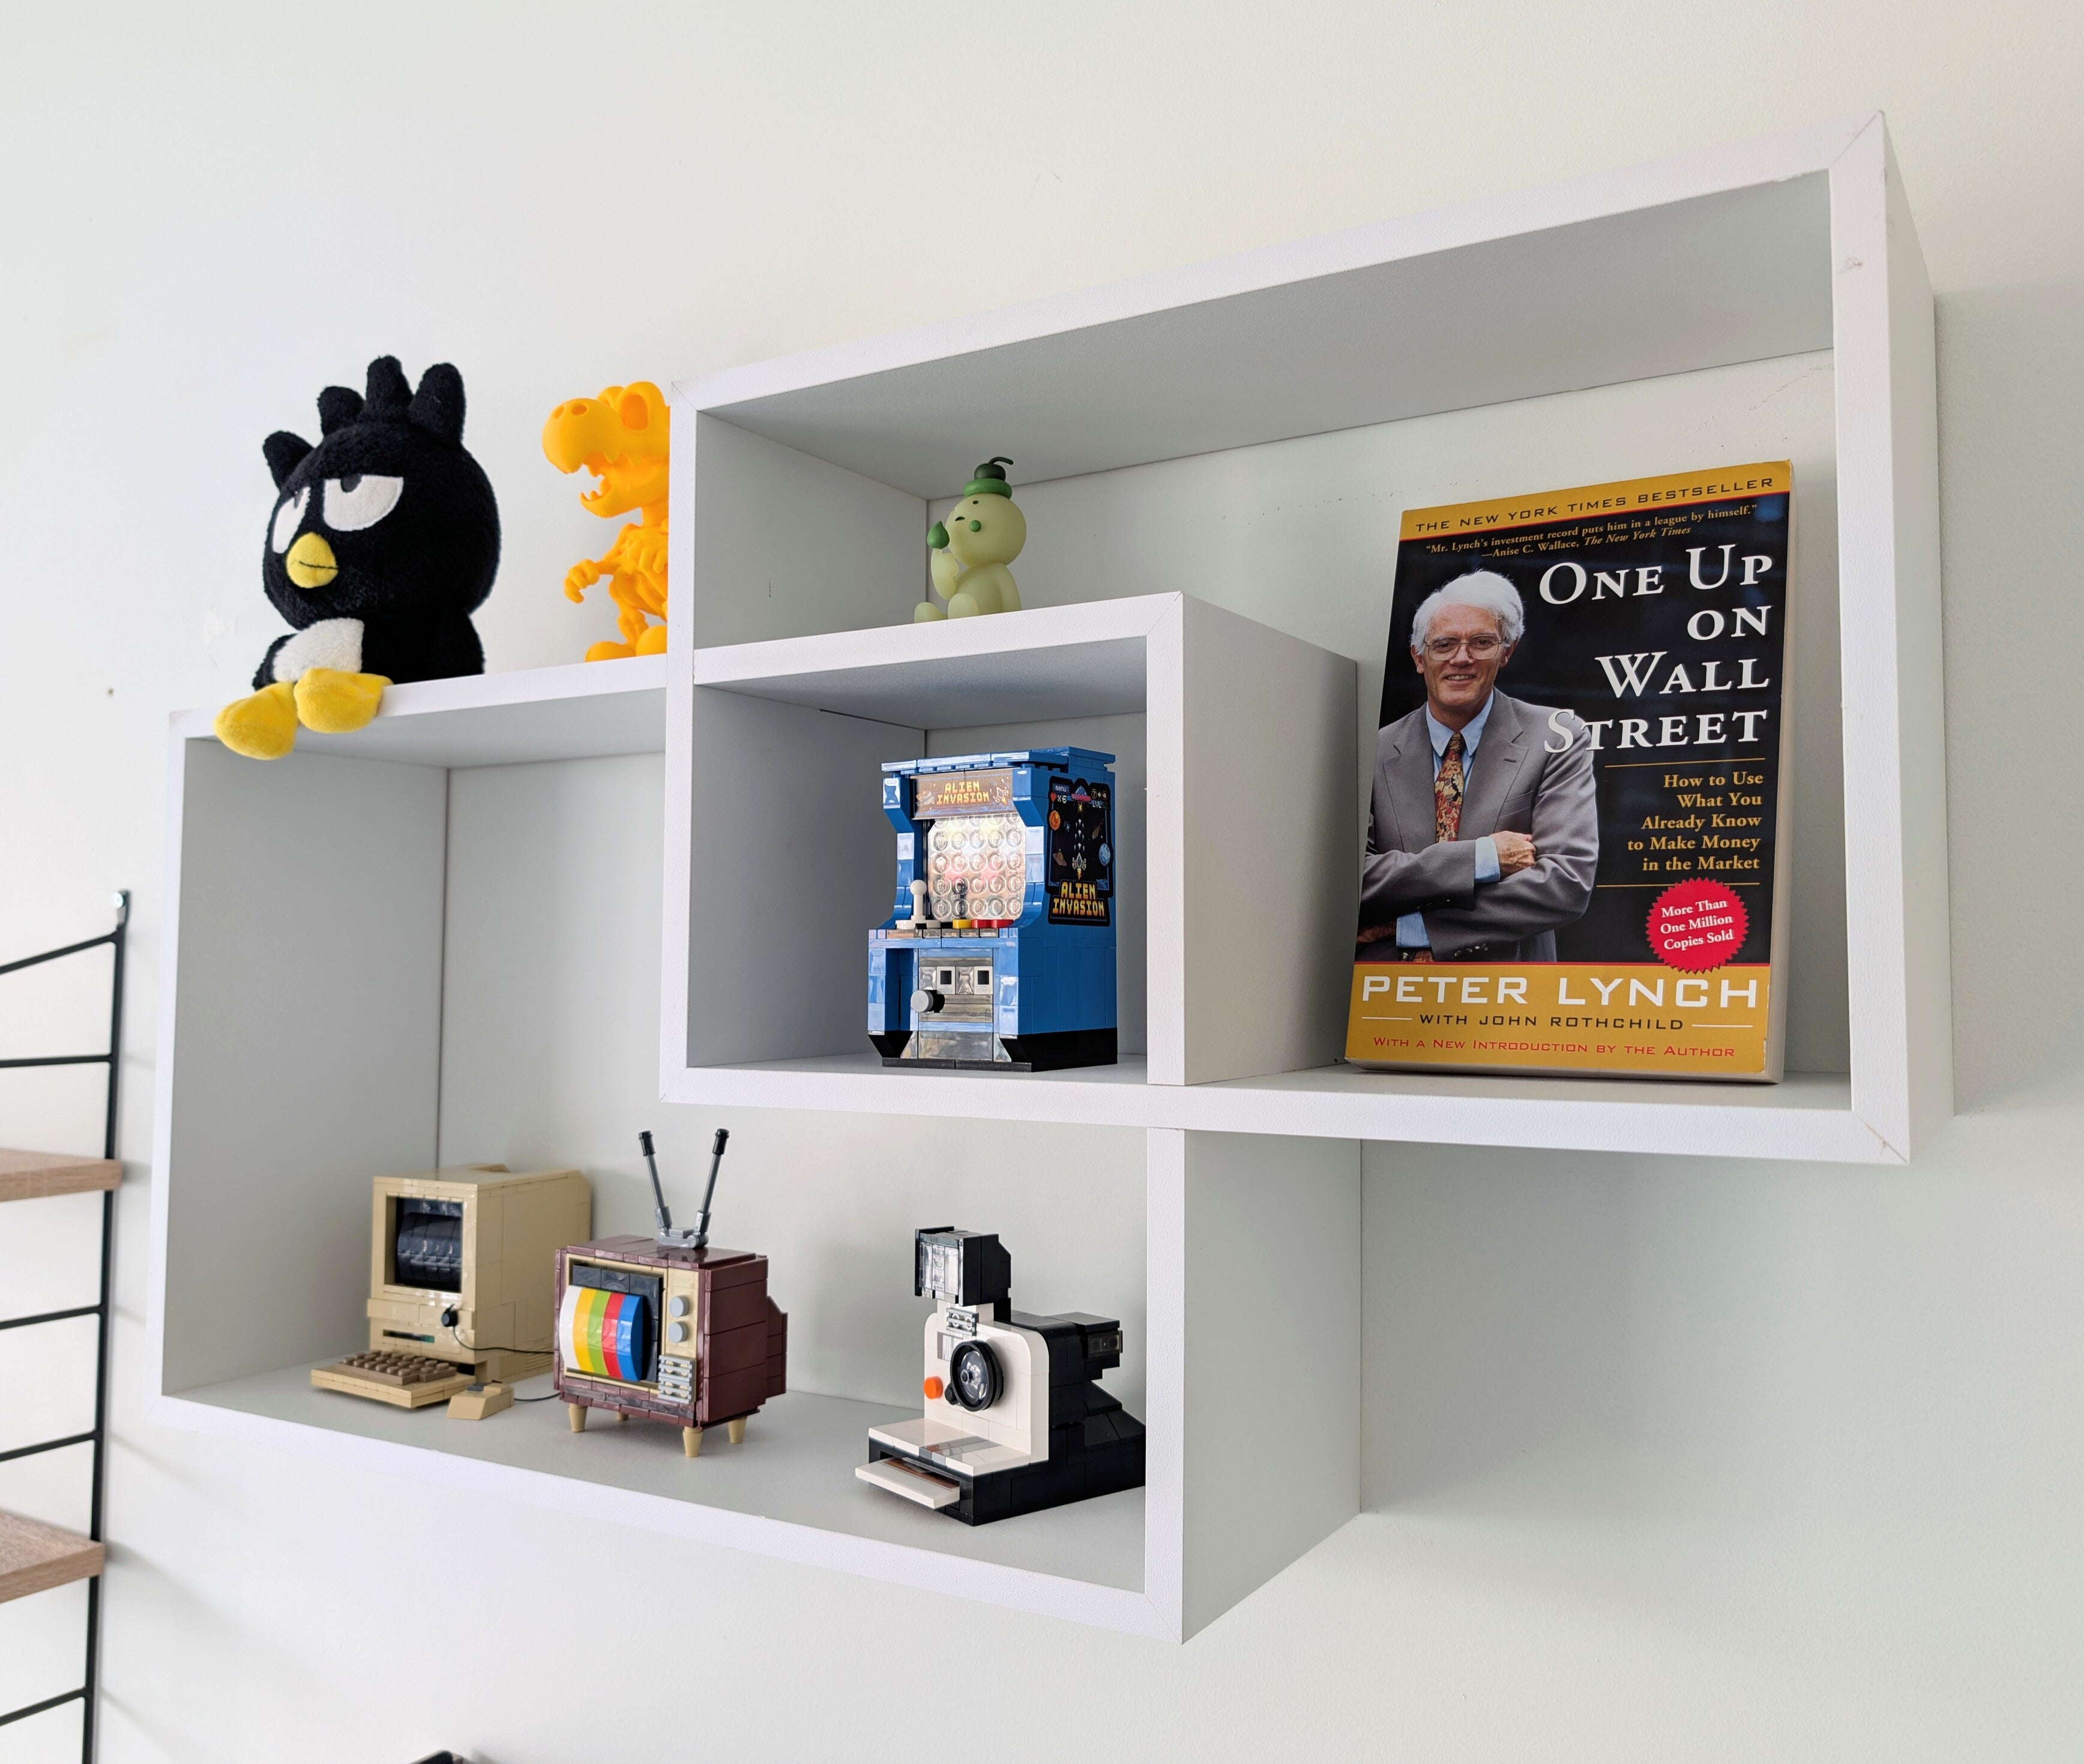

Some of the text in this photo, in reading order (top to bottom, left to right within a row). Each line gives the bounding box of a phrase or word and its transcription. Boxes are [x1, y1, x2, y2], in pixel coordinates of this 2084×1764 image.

[1416, 478, 1772, 532] THE NEW YORK TIMES BESTSELLER
[1453, 539, 1487, 552] Lynch’s
[1492, 533, 1543, 546] investment
[1547, 526, 1578, 538] record
[1582, 525, 1603, 537] puts
[1607, 522, 1627, 531] him
[1631, 520, 1641, 528] in
[1655, 516, 1687, 528] league
[1691, 513, 1704, 523] by
[1523, 545, 1534, 553] C.
[1538, 540, 1579, 552] Wallace,
[1585, 536, 1602, 546] The
[1606, 534, 1628, 544] New
[1632, 529, 1657, 540] York
[1661, 526, 1691, 537] Times
[945, 781, 980, 793] ALIEN
[1663, 771, 1763, 787] How to Use
[936, 792, 989, 805] INVASION
[1092, 800, 1101, 808] LVL
[1676, 792, 1762, 807] What You
[1640, 813, 1762, 832] Already Know
[1627, 834, 1760, 852] to Make Money
[1642, 855, 1759, 870] in the Market
[1061, 882, 1096, 900] ALIEN
[1053, 898, 1104, 917] INVASION
[1661, 900, 1727, 918] More Than
[1660, 915, 1733, 934] One Million
[1664, 929, 1733, 951] Copies Sold
[1362, 976, 1756, 1008] PETER LYNCH
[1420, 1014, 1683, 1030] WITH JOHN ROTHCHILD
[1624, 1046, 1655, 1055] THE
